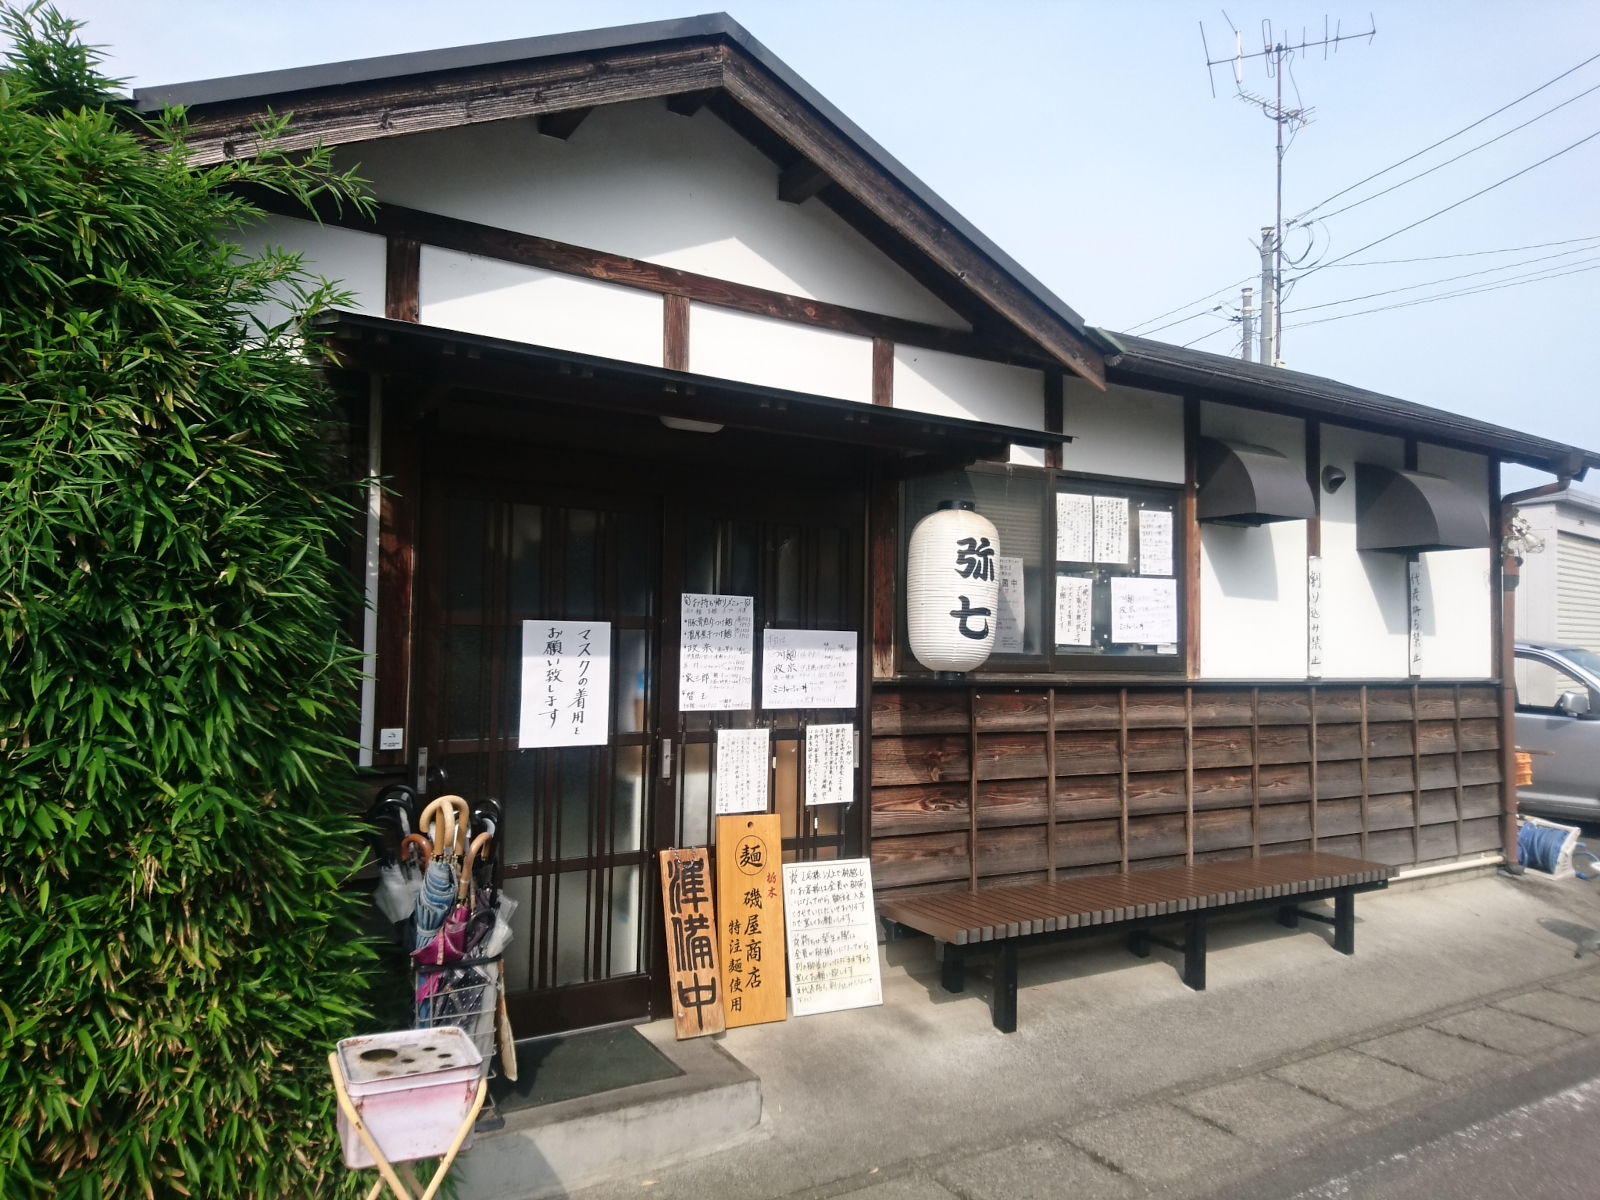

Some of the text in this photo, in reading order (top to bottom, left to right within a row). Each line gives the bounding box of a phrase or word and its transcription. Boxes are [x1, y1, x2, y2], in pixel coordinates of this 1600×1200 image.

[950, 537, 995, 640] 弥七
[1309, 570, 1322, 666] 割り込み禁止
[1411, 572, 1421, 663] 代表待ち禁止
[538, 627, 564, 729] お願い致します
[567, 629, 592, 736] マスクの着用を
[767, 872, 778, 899] 栃木
[667, 857, 717, 1032] 準備中
[728, 919, 743, 1012] 特注麺使用
[743, 887, 763, 988] 磯屋商店
